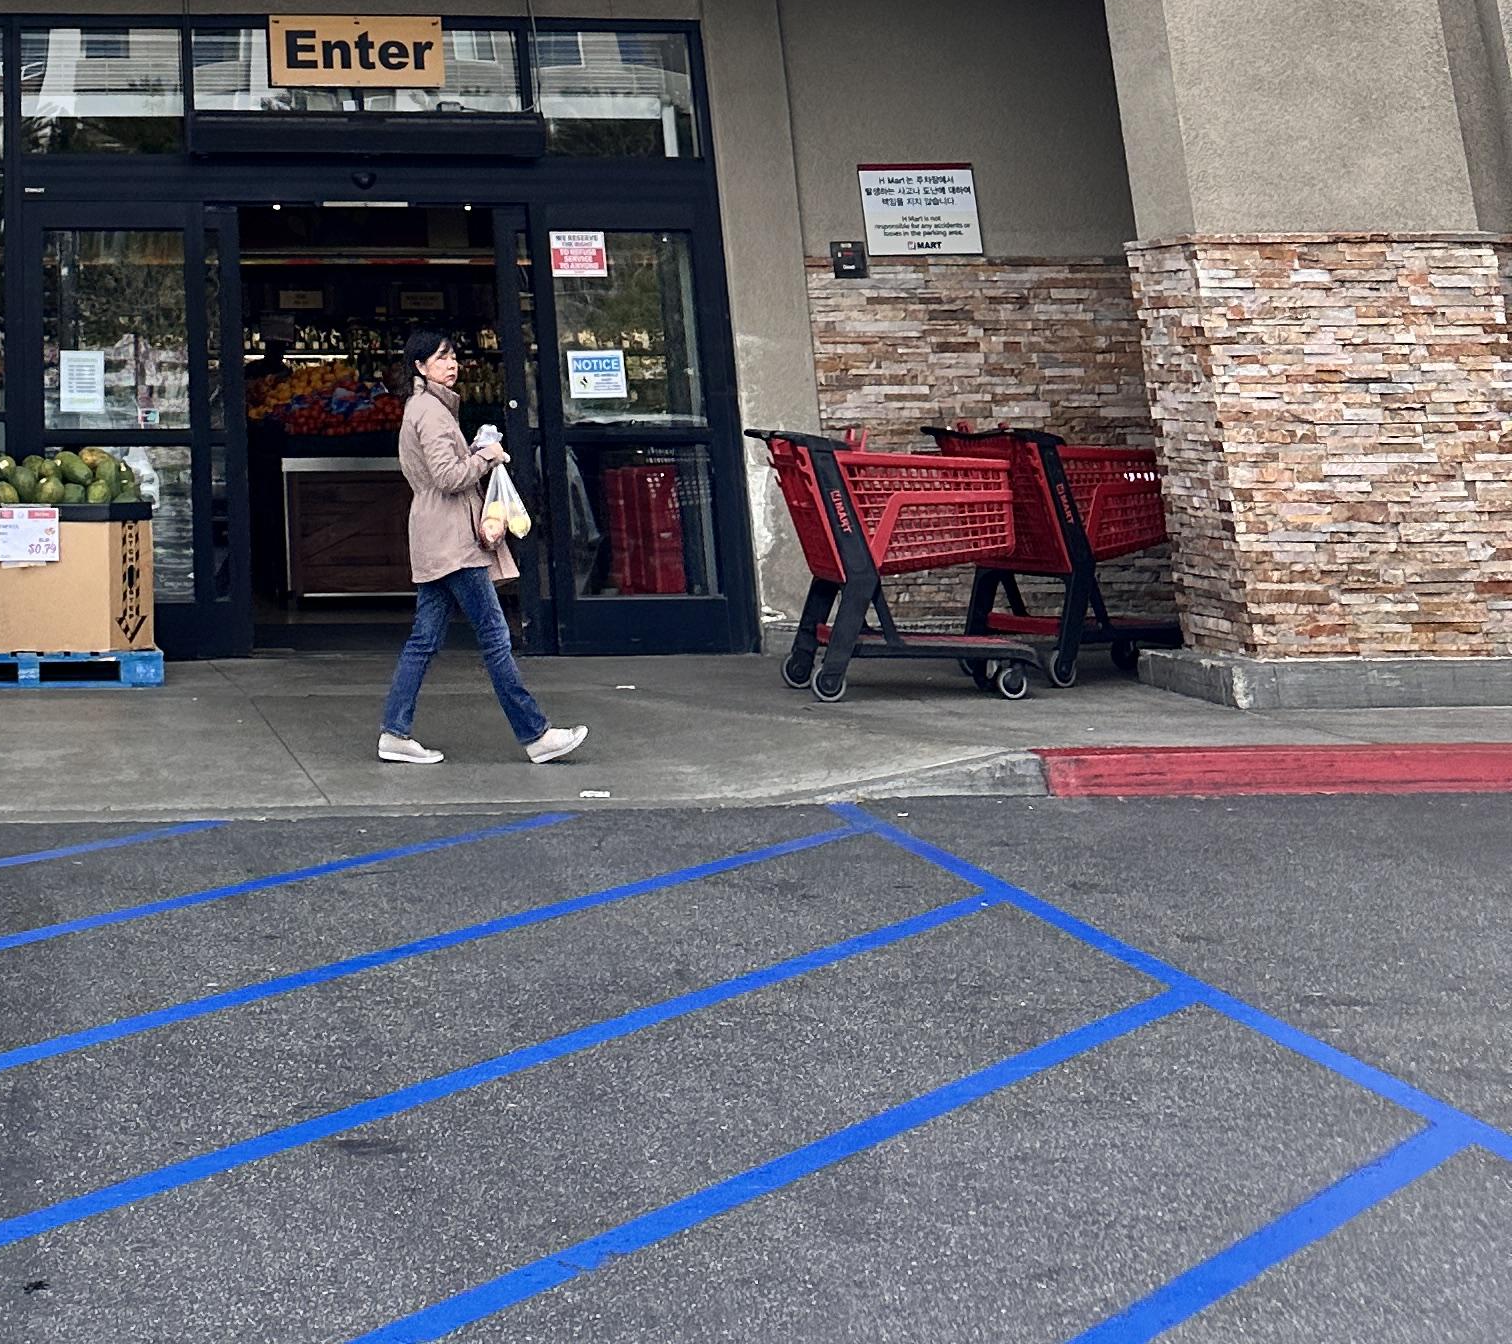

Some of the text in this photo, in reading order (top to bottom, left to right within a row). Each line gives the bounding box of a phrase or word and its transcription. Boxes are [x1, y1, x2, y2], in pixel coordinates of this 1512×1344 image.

[285, 29, 434, 71] Enter
[573, 359, 619, 370] NOTICE
[835, 502, 852, 533] MART
